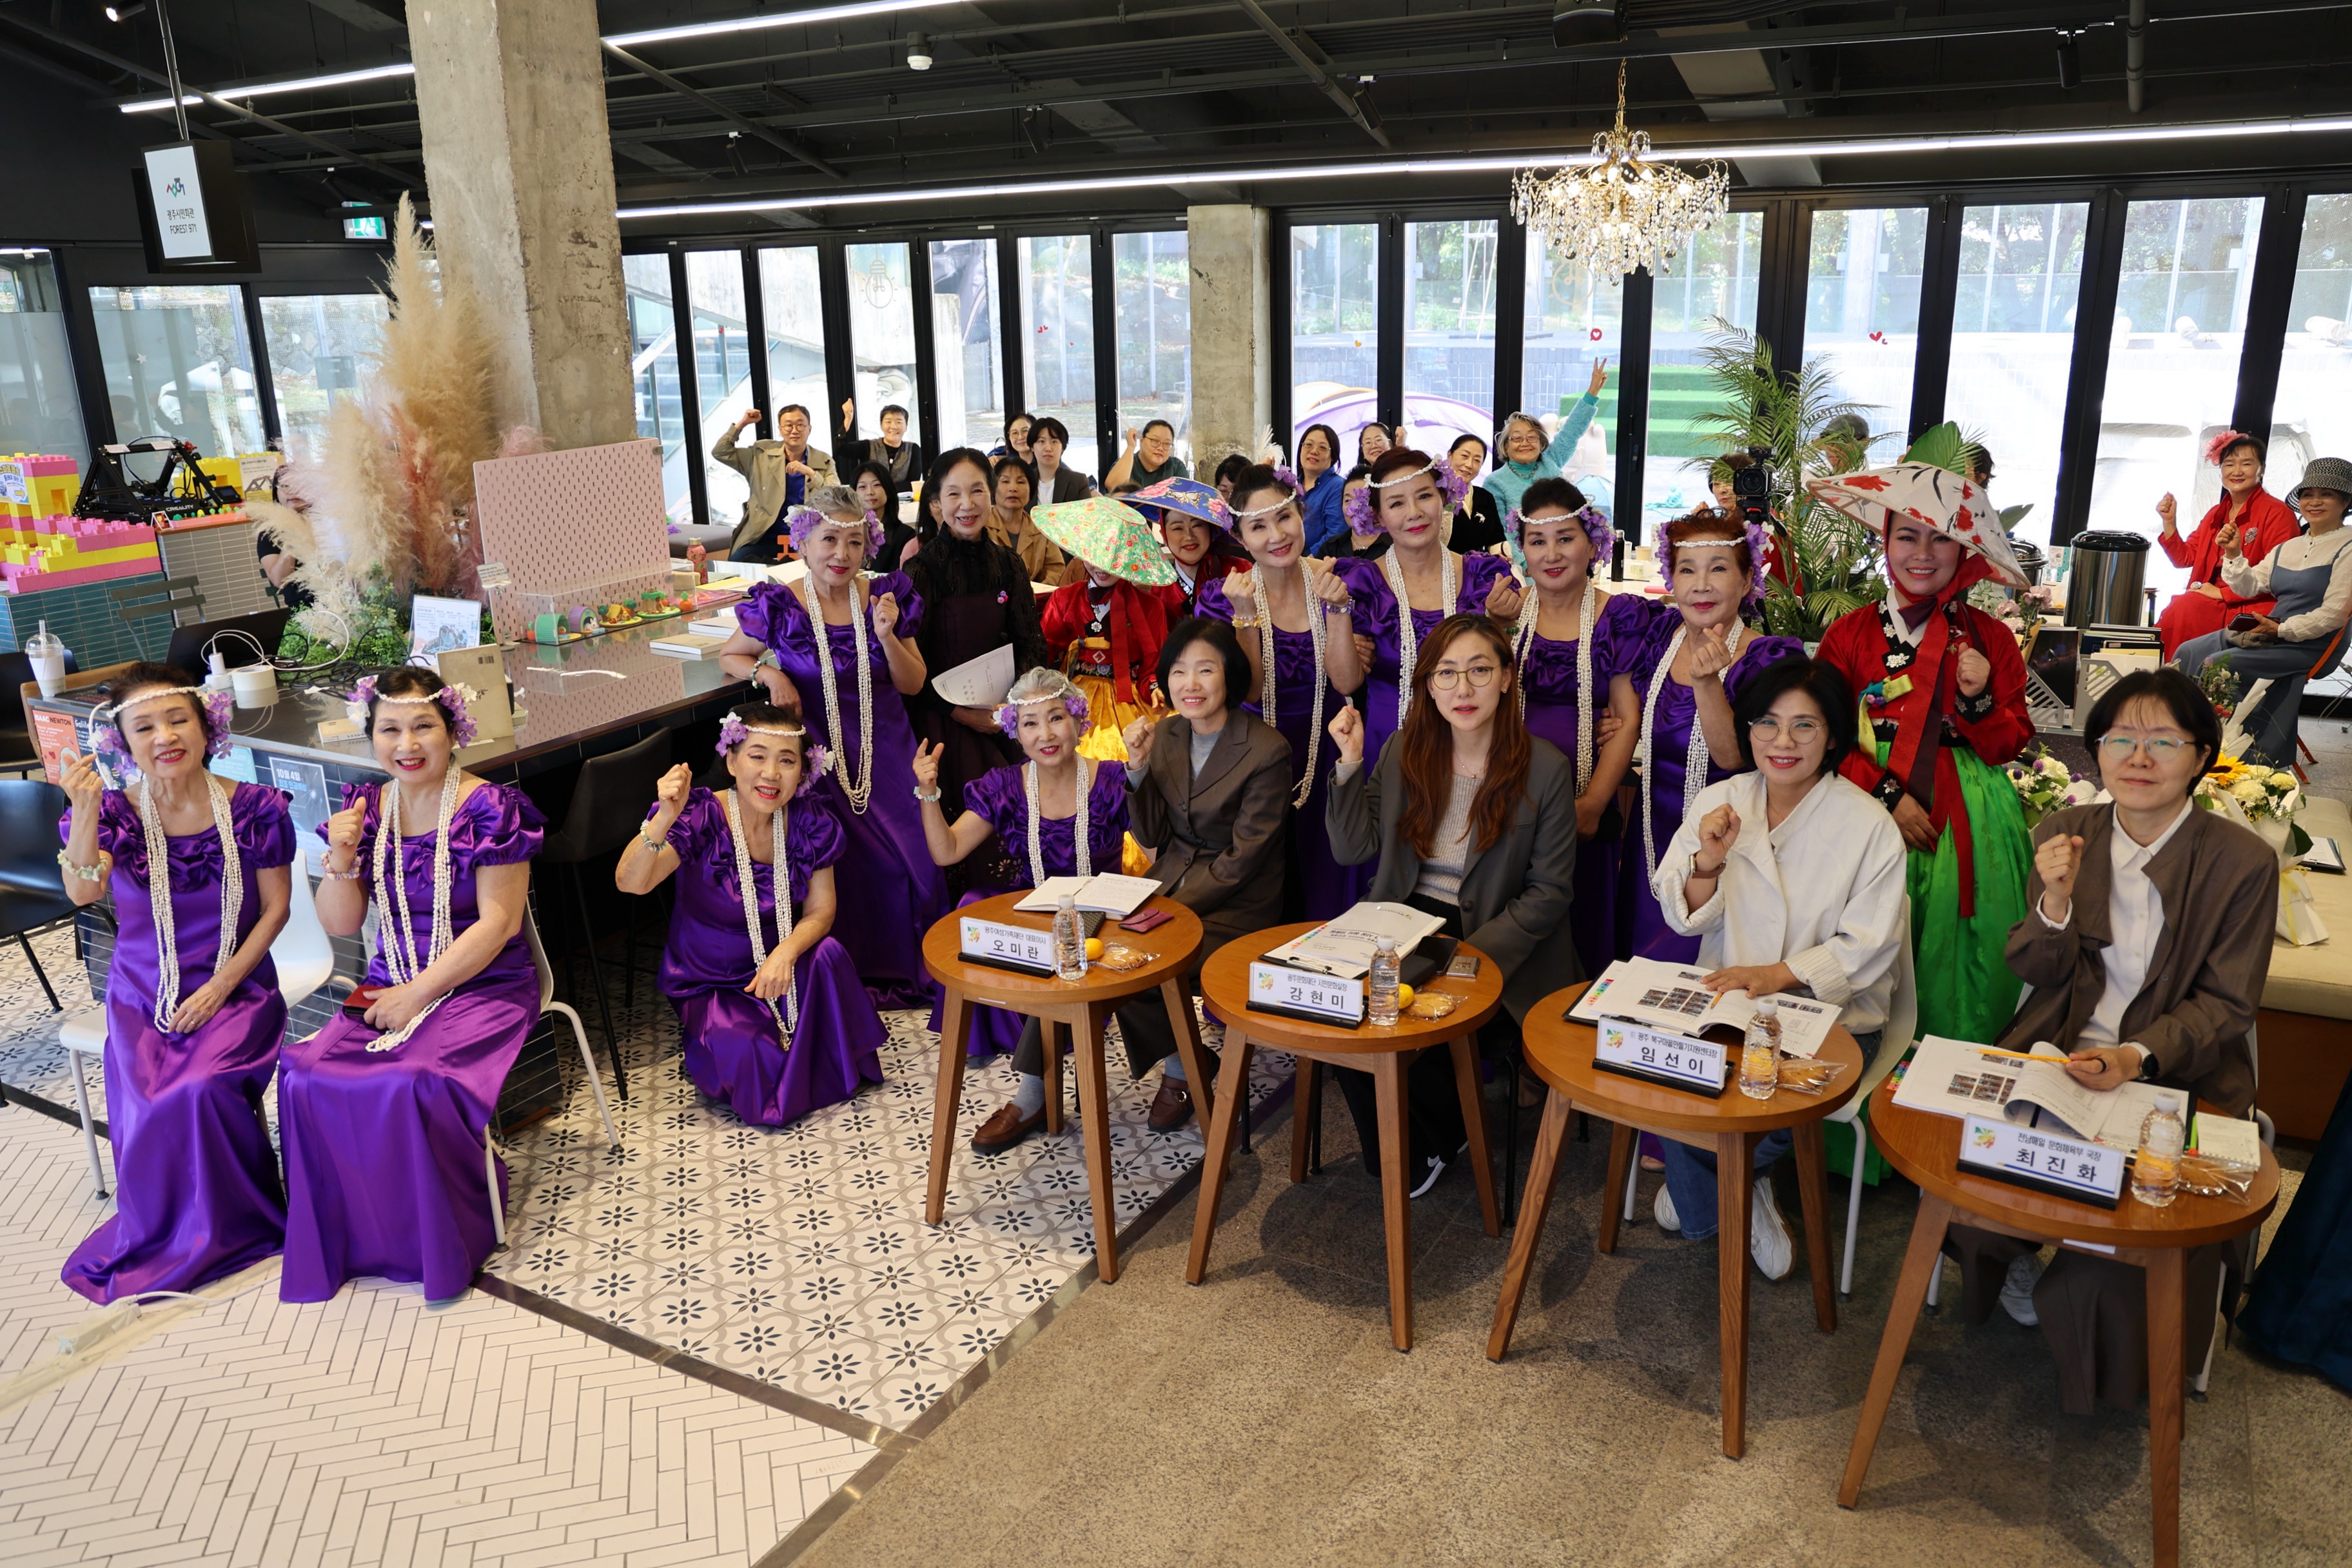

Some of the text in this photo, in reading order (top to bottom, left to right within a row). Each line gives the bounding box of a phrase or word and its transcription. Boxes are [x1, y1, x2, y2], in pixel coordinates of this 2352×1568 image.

[166, 208, 195, 220] 광주시민회관
[170, 224, 197, 234] FOREST 971
[34, 714, 72, 726] ISAAC NEWTON
[277, 769, 300, 781] 10월 4일
[985, 926, 1046, 945] 광주여성가족재단 대표이사
[1288, 974, 1347, 992] 광주문화재단 시민문화실장
[1638, 1032, 1649, 1042] 광주
[1651, 1035, 1718, 1058] 북구마을만들기지원센터장
[2018, 1133, 2101, 1161] 전남매일 문화체육부 국장
